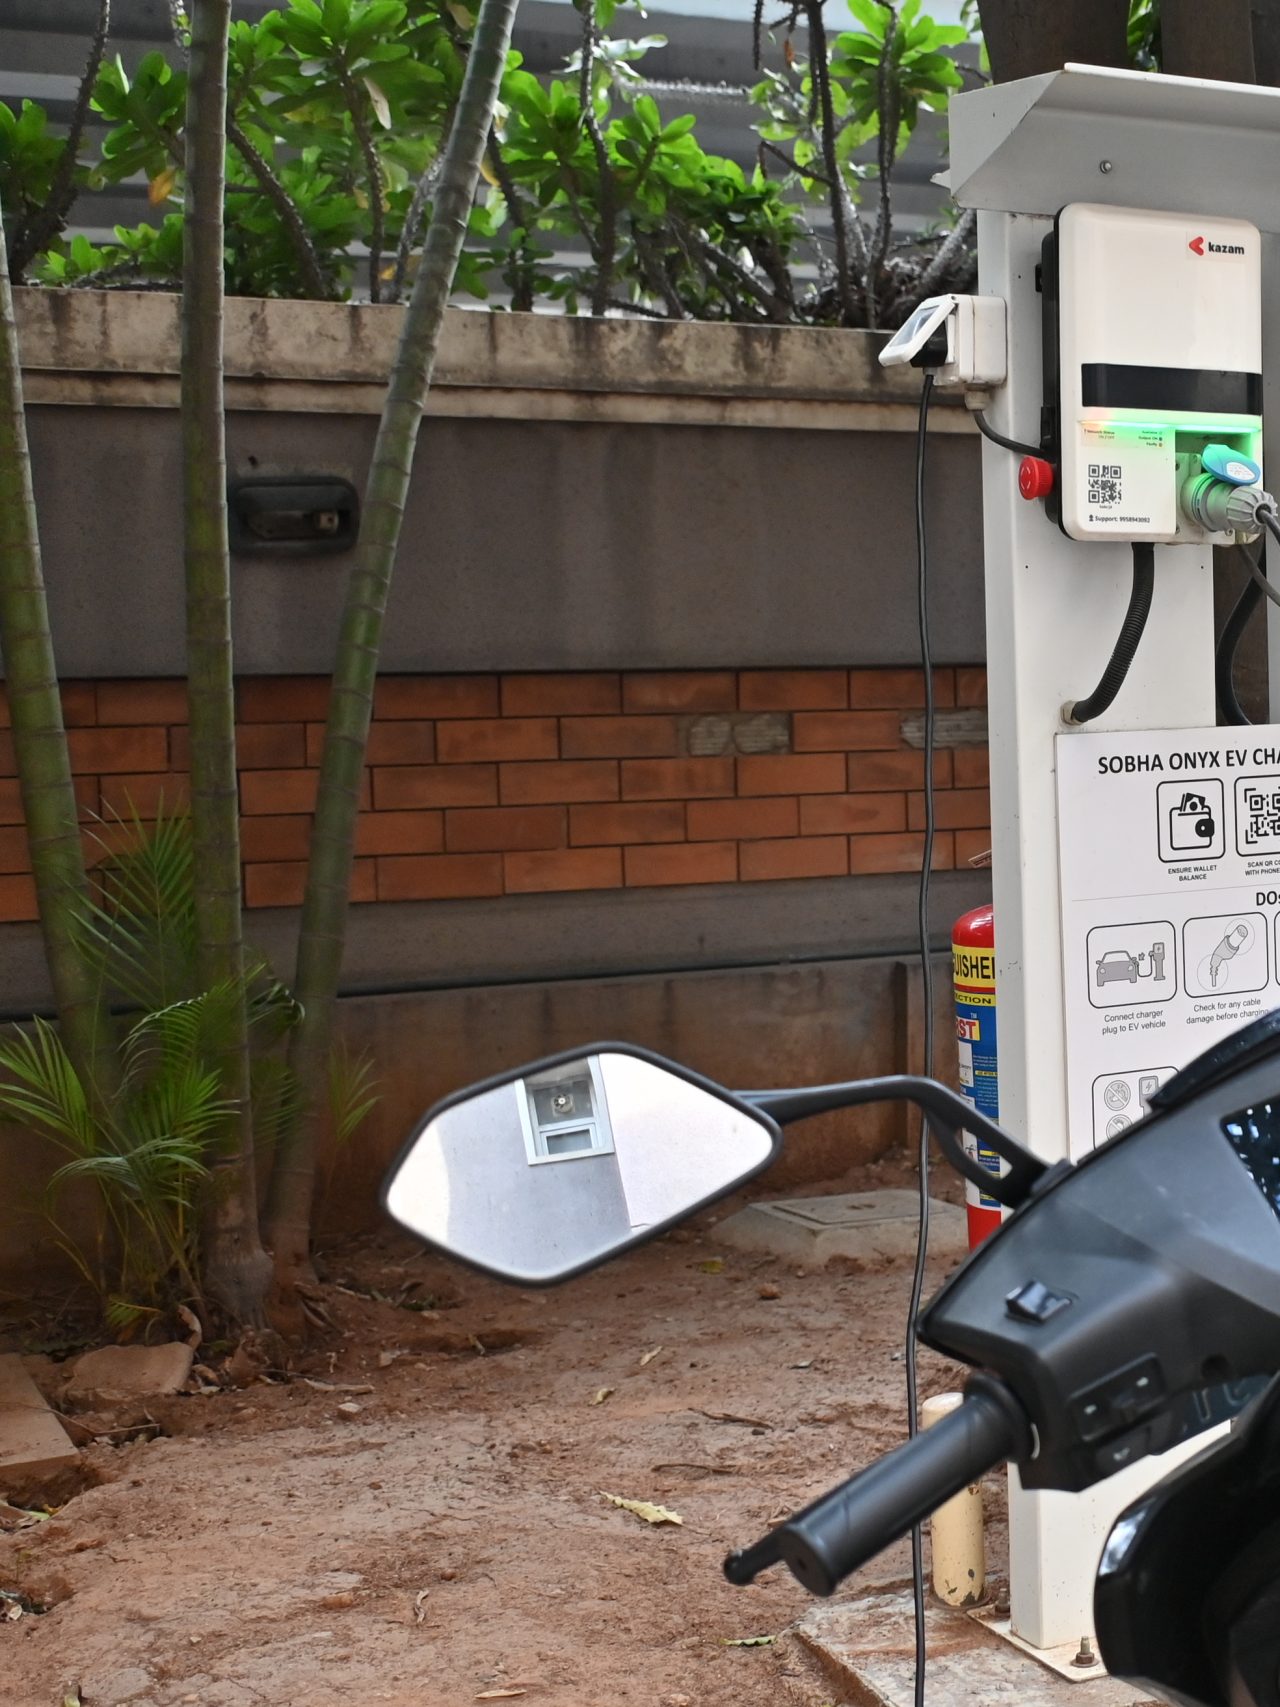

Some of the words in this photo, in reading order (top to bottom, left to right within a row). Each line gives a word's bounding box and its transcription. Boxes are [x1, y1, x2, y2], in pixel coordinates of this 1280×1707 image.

[1208, 241, 1245, 255] kazam
[1098, 754, 1164, 774] SOBHA
[1169, 751, 1220, 770] ONYX
[1226, 749, 1247, 767] EV
[1168, 866, 1193, 874] ENSURE
[1193, 865, 1217, 873] WALLET
[1245, 868, 1260, 876] WITH
[1260, 867, 1280, 875] PHONE
[1193, 1002, 1216, 1012] Check
[1217, 1001, 1227, 1010] for
[1228, 1001, 1241, 1010] any
[1242, 998, 1261, 1007] cable
[1104, 1012, 1135, 1023] Connect
[1136, 1009, 1164, 1020] charger
[1186, 1015, 1215, 1025] damage
[1216, 1011, 1238, 1021] before
[1102, 1024, 1118, 1035] plug
[1119, 1024, 1127, 1032] to
[1128, 1022, 1140, 1031] EV
[1141, 1020, 1166, 1029] vehicle
